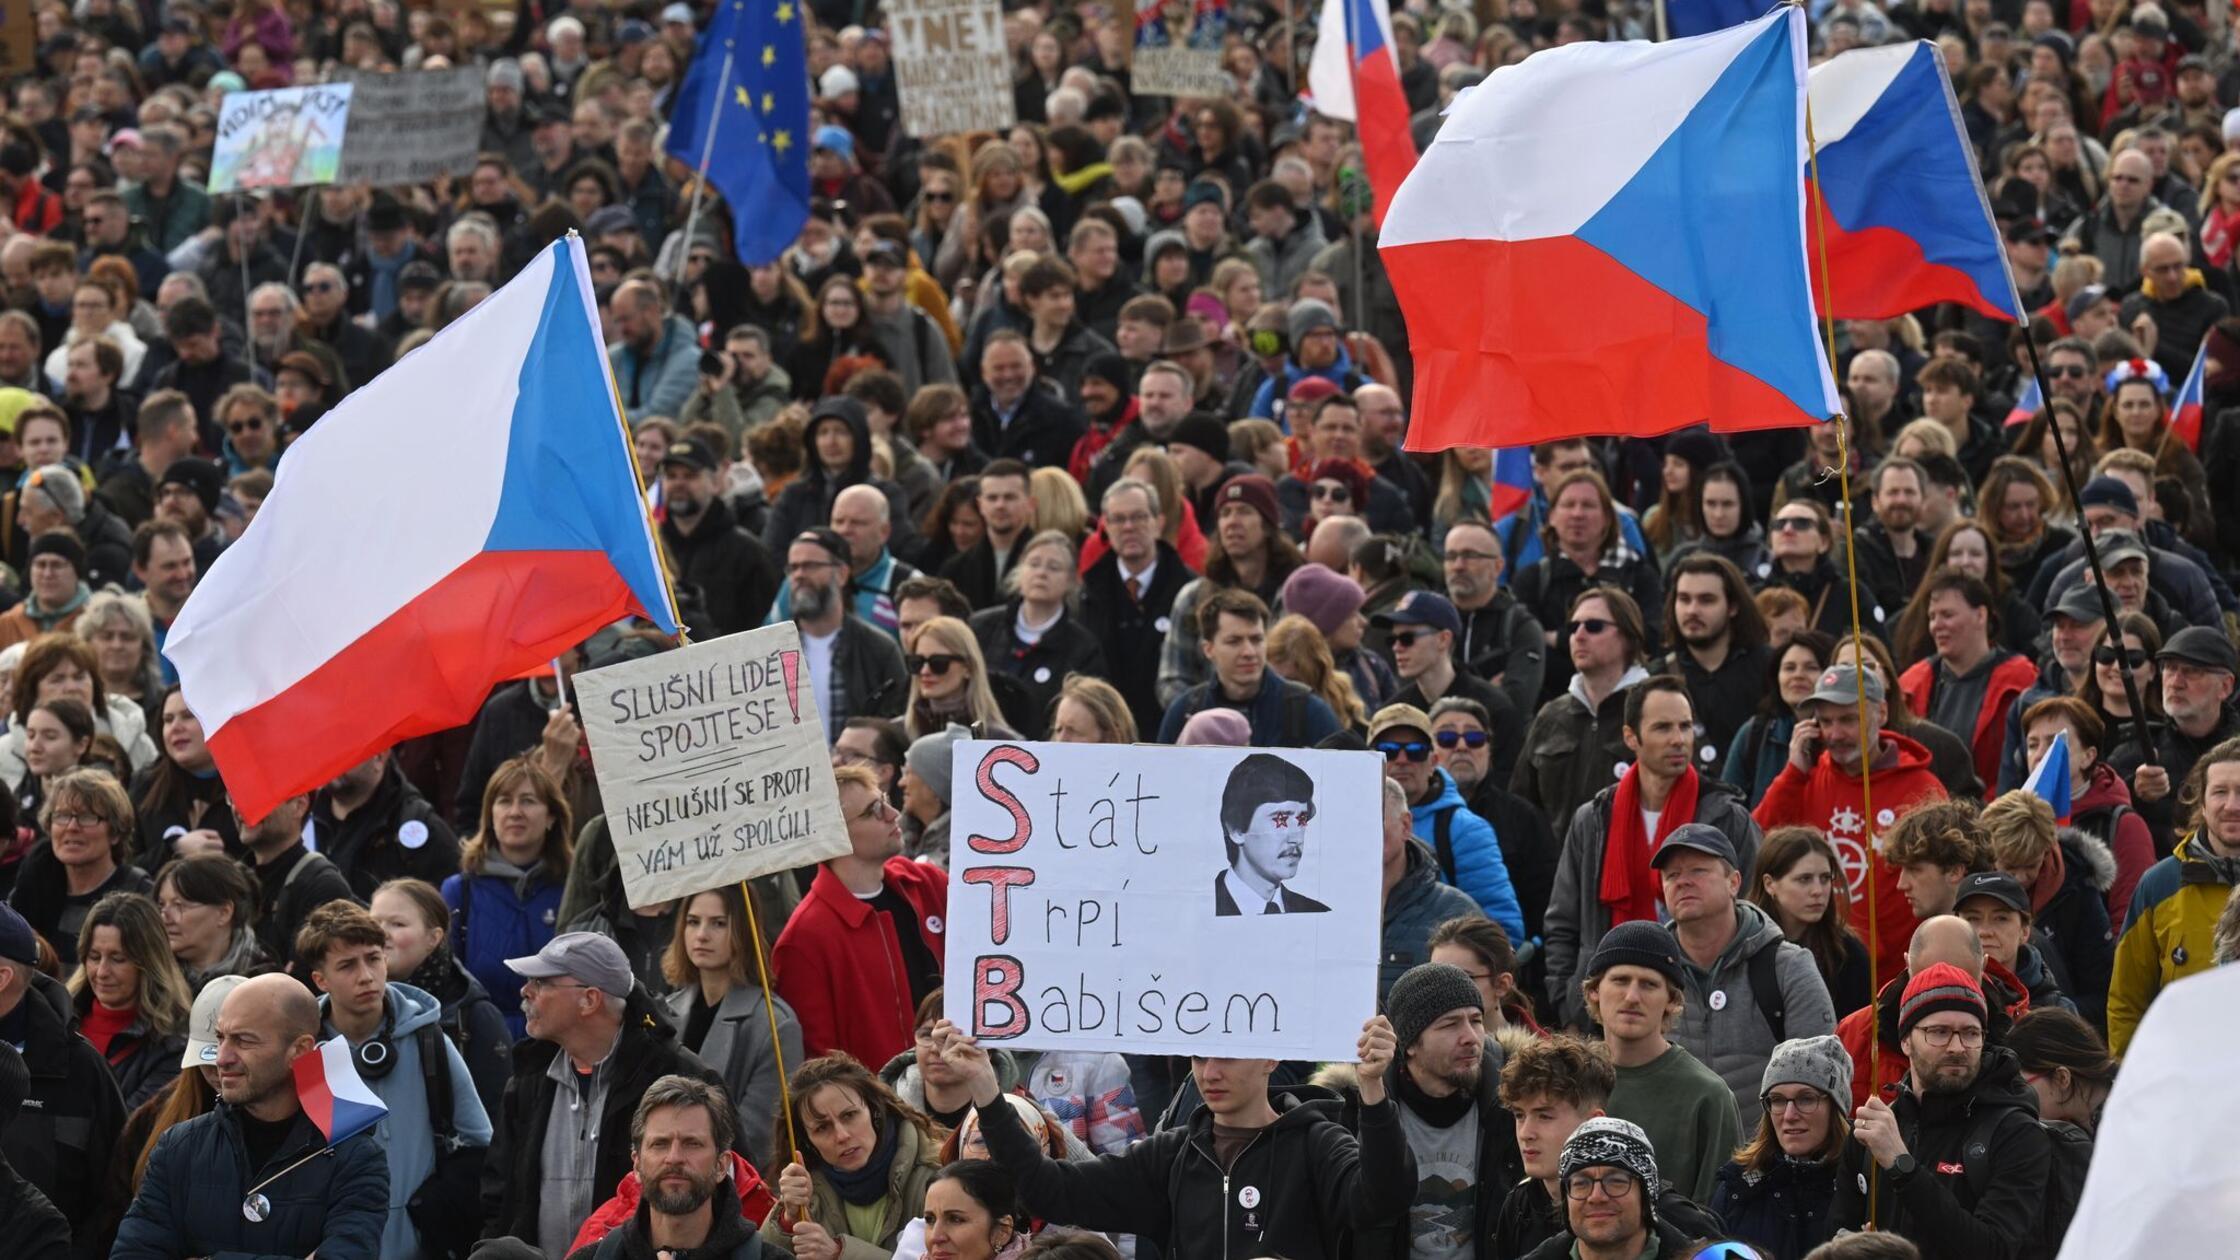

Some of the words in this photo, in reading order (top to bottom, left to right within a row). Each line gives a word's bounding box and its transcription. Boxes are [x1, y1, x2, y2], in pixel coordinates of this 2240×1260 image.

[611, 663, 718, 723] SLUŠNÍ
[626, 777, 730, 835] NESLUŠNÍ
[734, 779, 755, 806] SE
[761, 766, 810, 802] PROTI
[967, 744, 1160, 855] Stát
[636, 840, 685, 875] VÁM
[694, 823, 724, 861] UŽ
[732, 806, 817, 853] SPOLČILI.
[962, 865, 1129, 947] Trpí
[971, 953, 1281, 1040] Babišem
